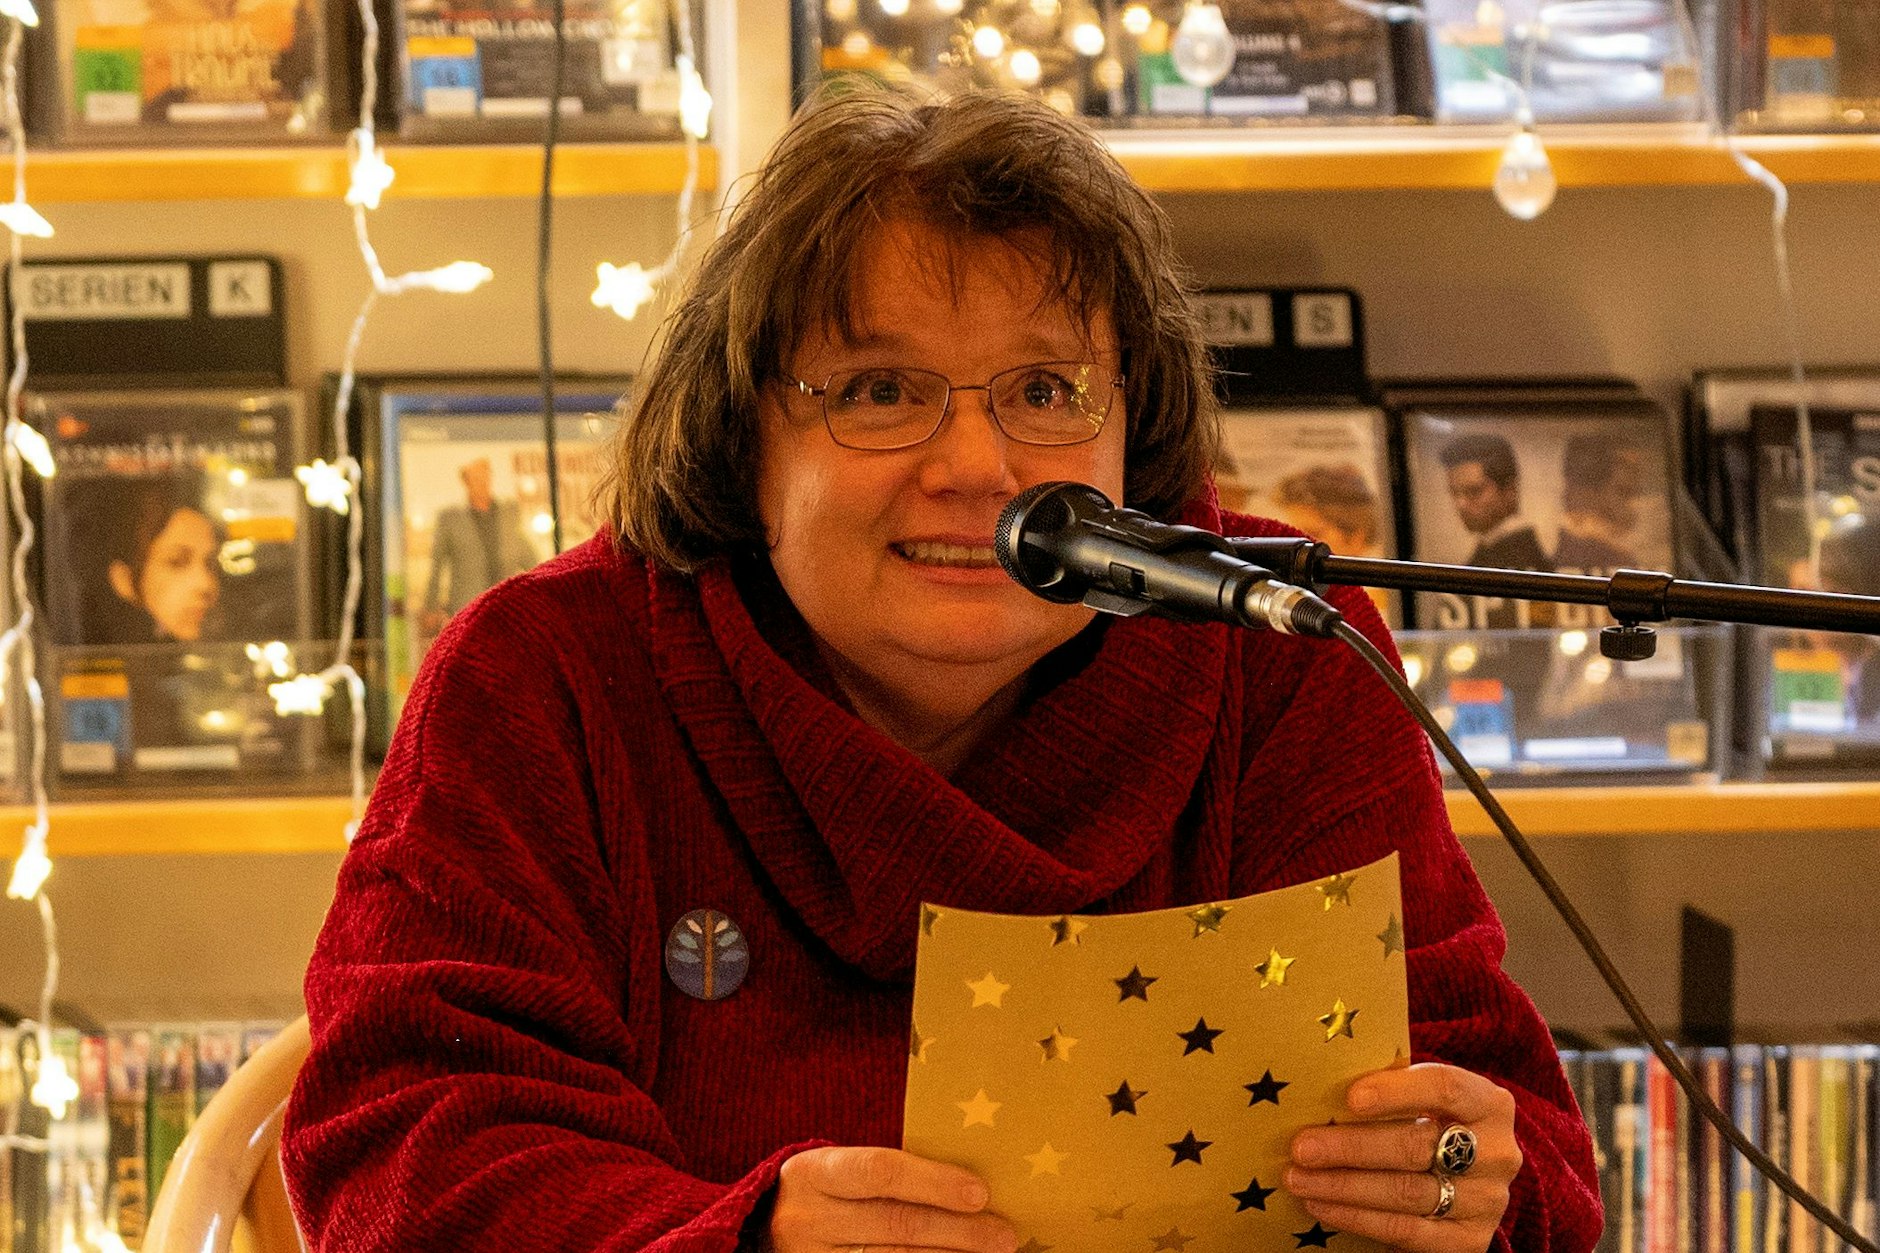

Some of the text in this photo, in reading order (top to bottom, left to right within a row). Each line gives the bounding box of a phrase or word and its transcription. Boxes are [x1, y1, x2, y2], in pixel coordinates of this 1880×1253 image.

[31, 274, 174, 306] SERIEN
[227, 274, 252, 303] K
[1310, 302, 1334, 335] S
